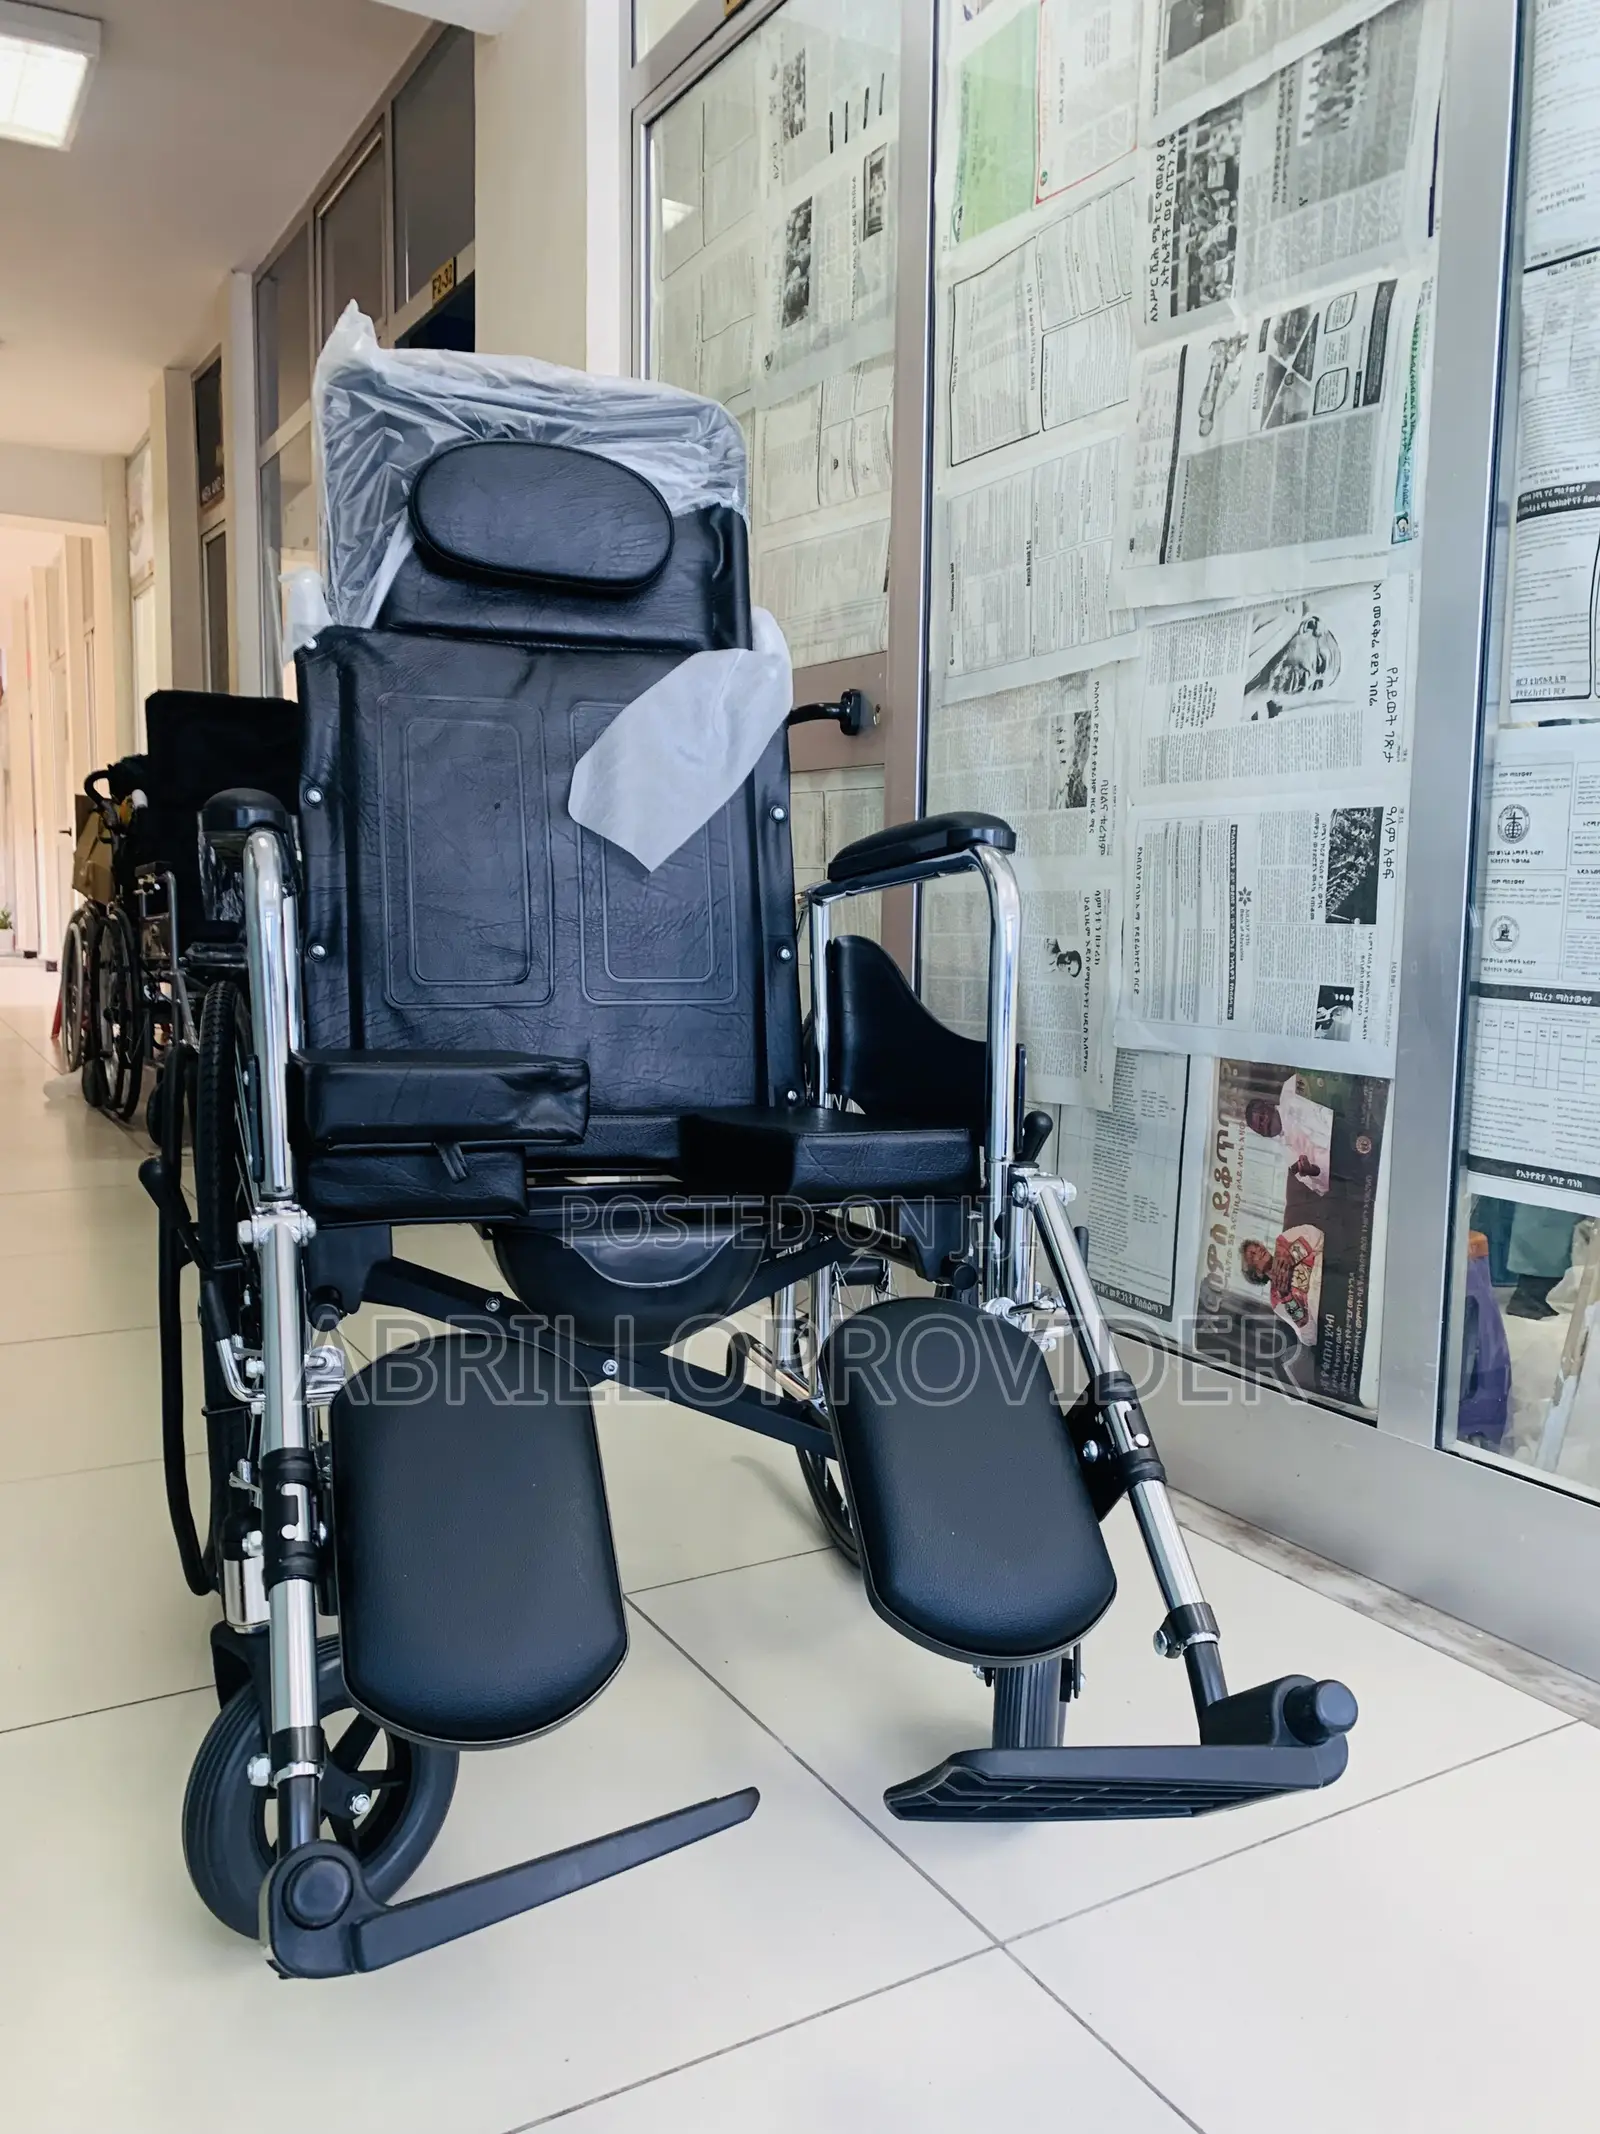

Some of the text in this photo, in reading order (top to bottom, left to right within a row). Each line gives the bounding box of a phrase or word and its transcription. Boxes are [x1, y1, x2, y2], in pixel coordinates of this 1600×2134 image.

[432, 264, 453, 300] F2-32
[1369, 652, 1379, 676] የደን
[1369, 681, 1379, 707] ገበሬ
[1382, 666, 1399, 764] የሕይወት ገጽታ
[1382, 806, 1398, 880] ዓለም አቀፍ
